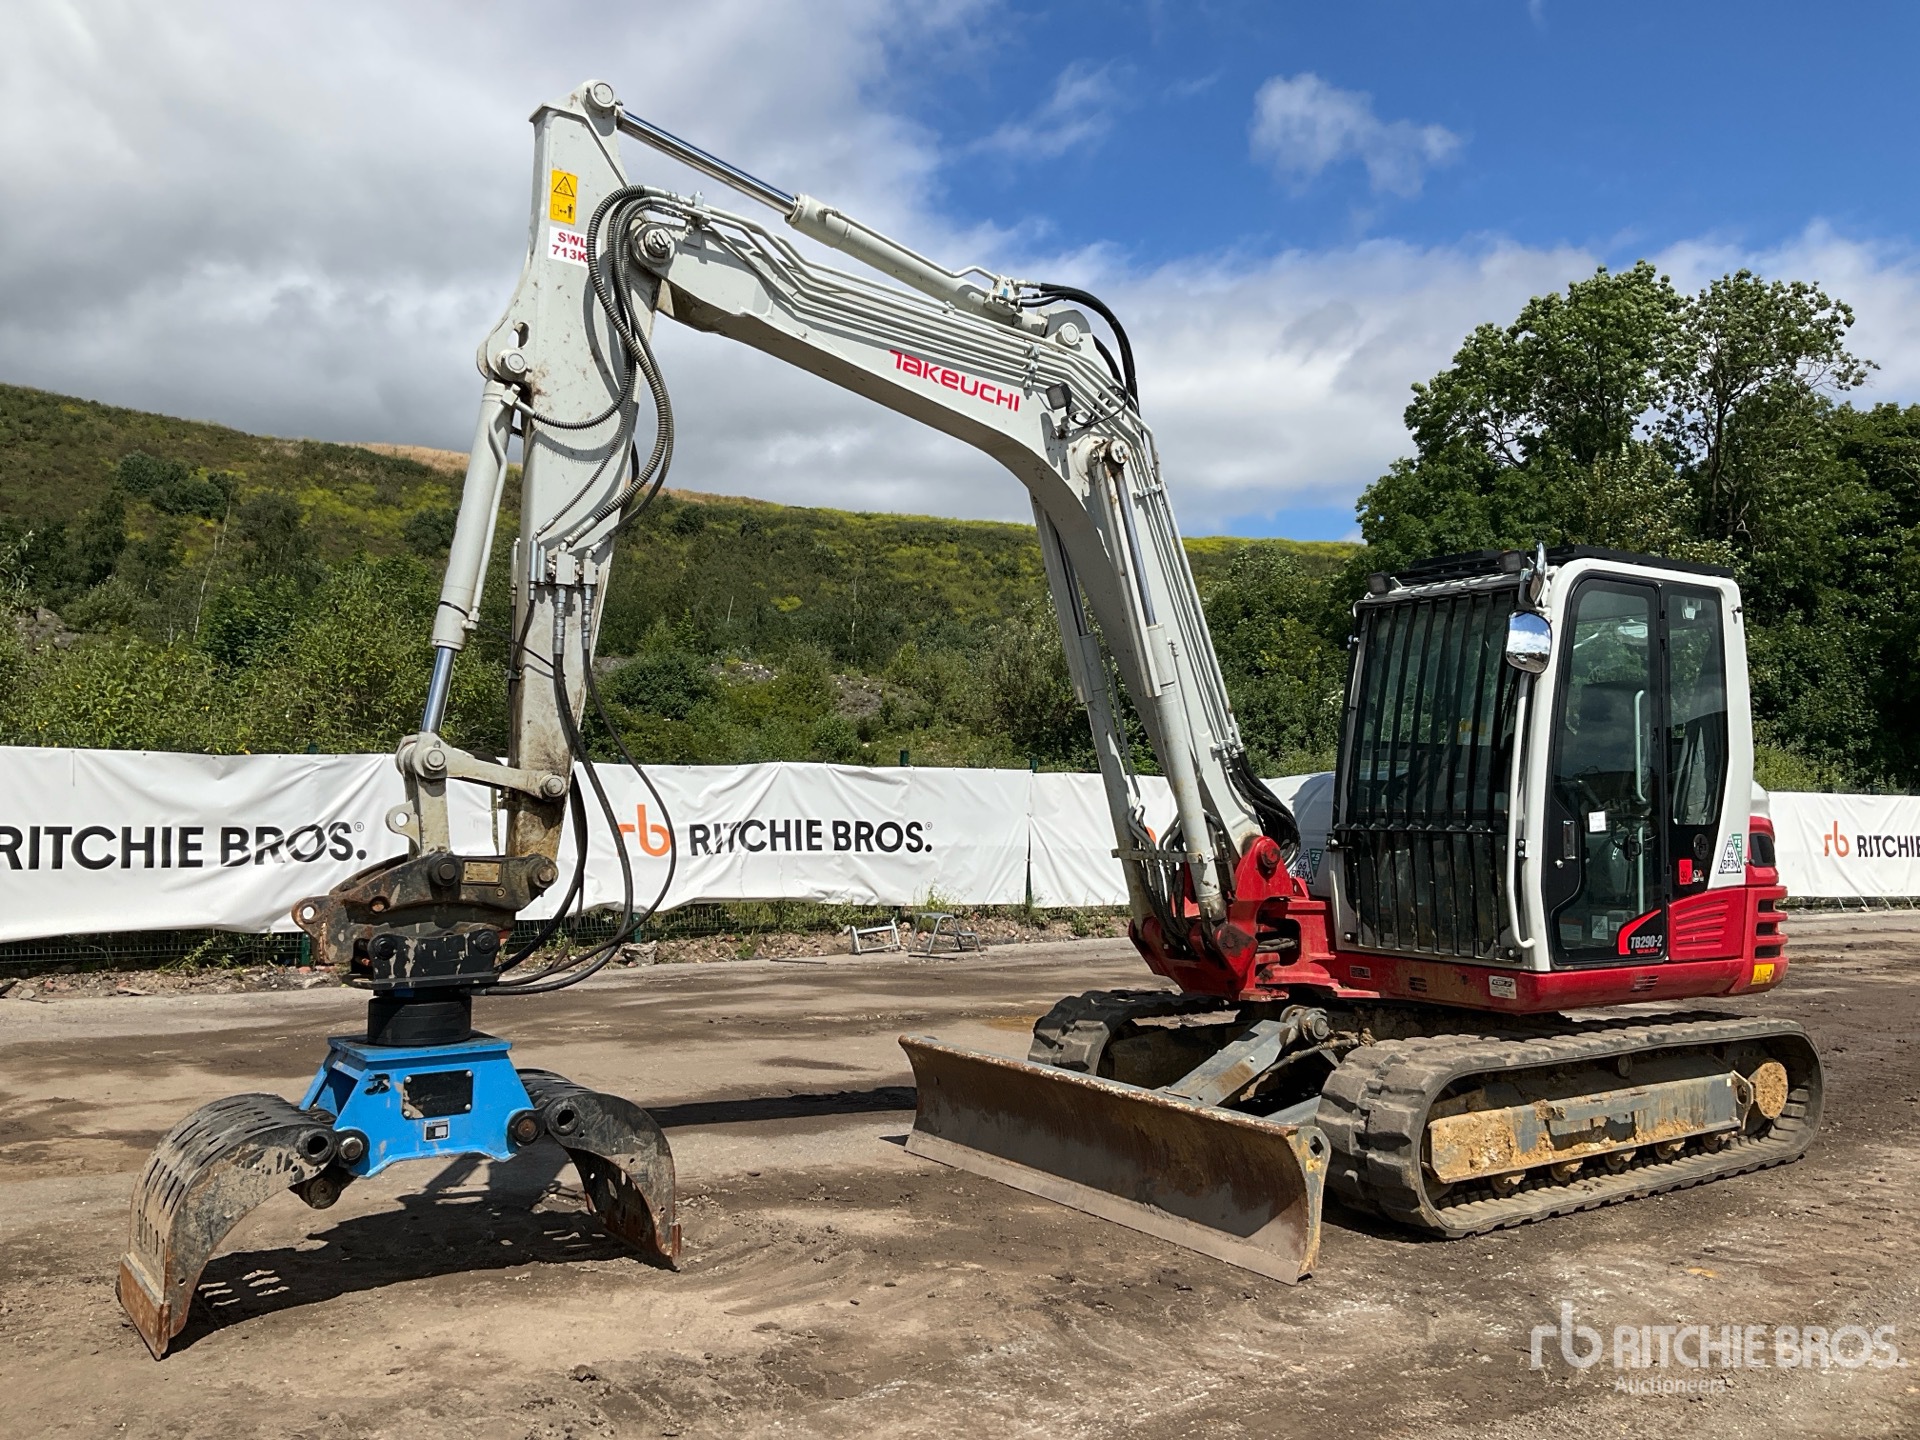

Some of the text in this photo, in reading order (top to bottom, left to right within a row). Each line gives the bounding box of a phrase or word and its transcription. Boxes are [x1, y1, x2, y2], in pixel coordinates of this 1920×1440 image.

[558, 231, 587, 248] SWL
[552, 244, 589, 263] 713K
[689, 819, 823, 856] RITCHIE
[0, 826, 204, 870] RITCHIE
[1631, 935, 1663, 949] TB290-2
